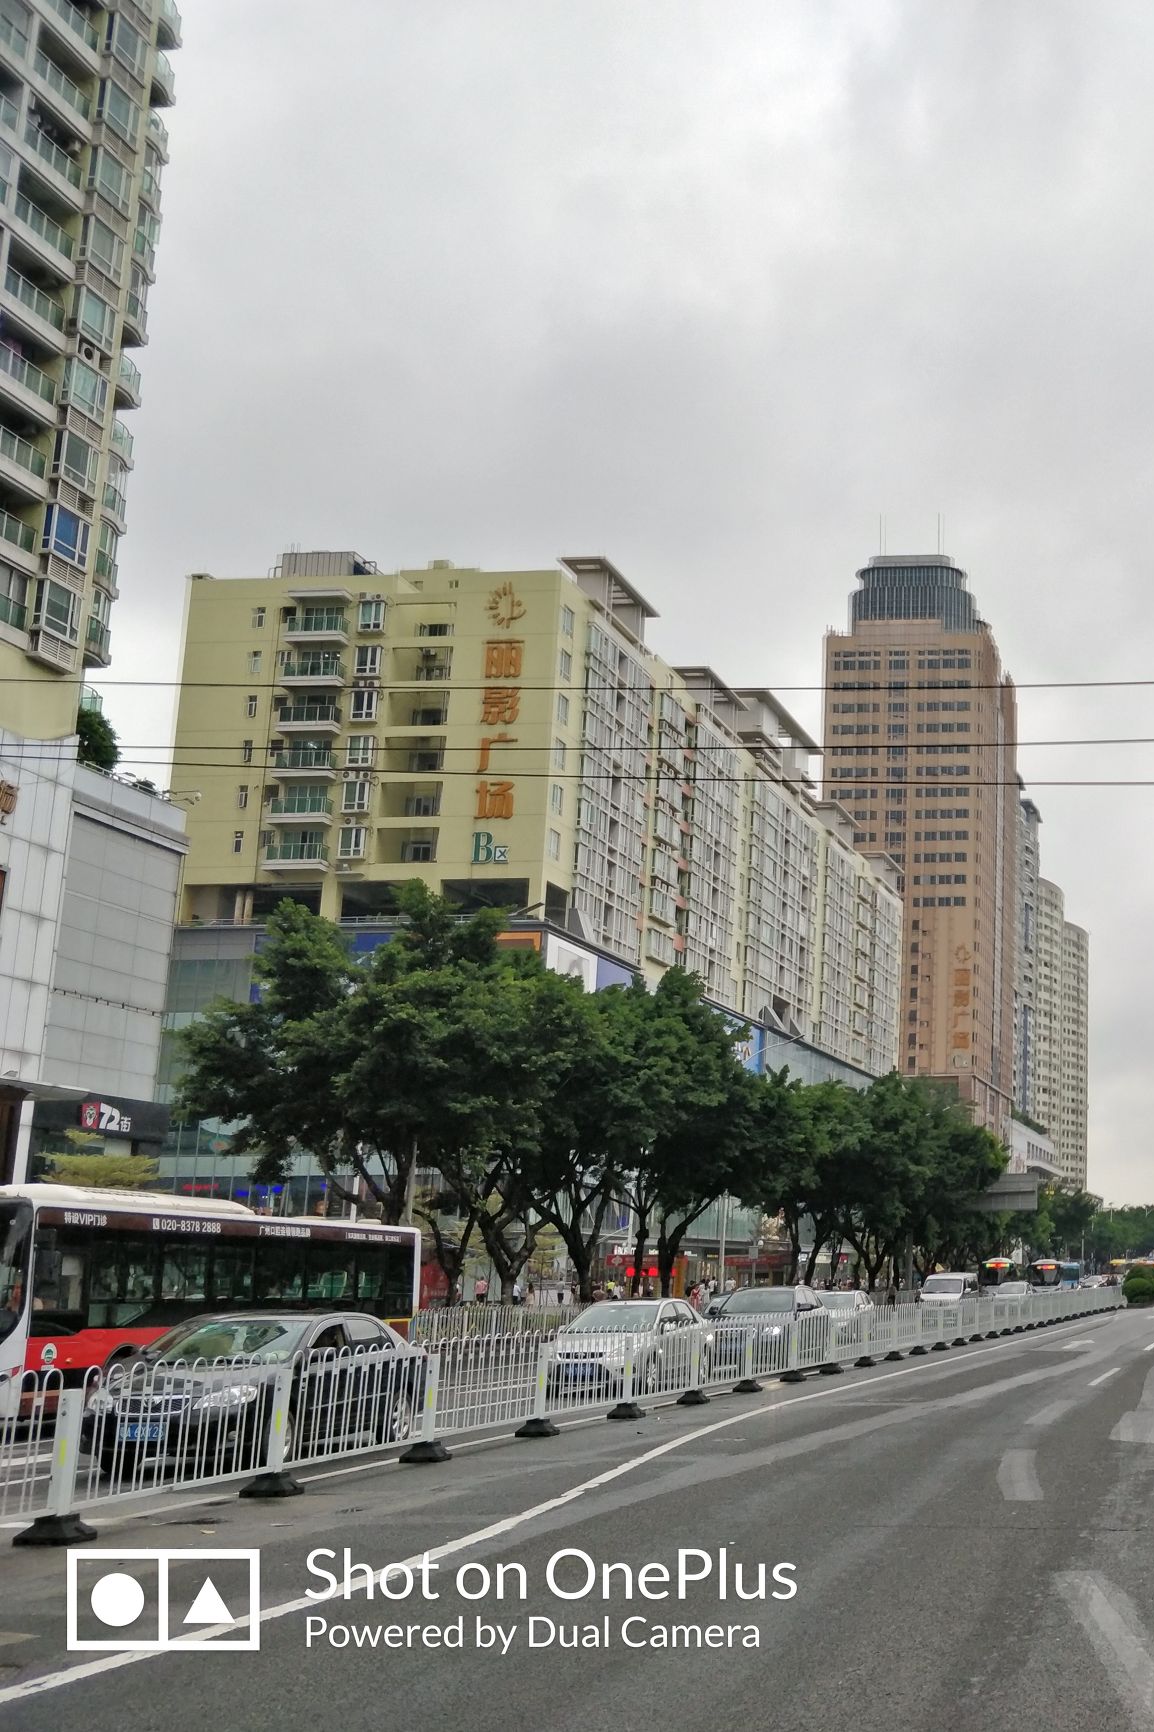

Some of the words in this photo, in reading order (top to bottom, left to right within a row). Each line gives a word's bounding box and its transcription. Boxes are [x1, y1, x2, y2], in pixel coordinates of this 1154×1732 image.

[474, 639, 525, 820] 丽影广场
[471, 831, 509, 864] B区
[98, 1102, 131, 1132] 72街
[161, 1218, 200, 1232] 020-8378
[201, 1221, 221, 1234] 2888
